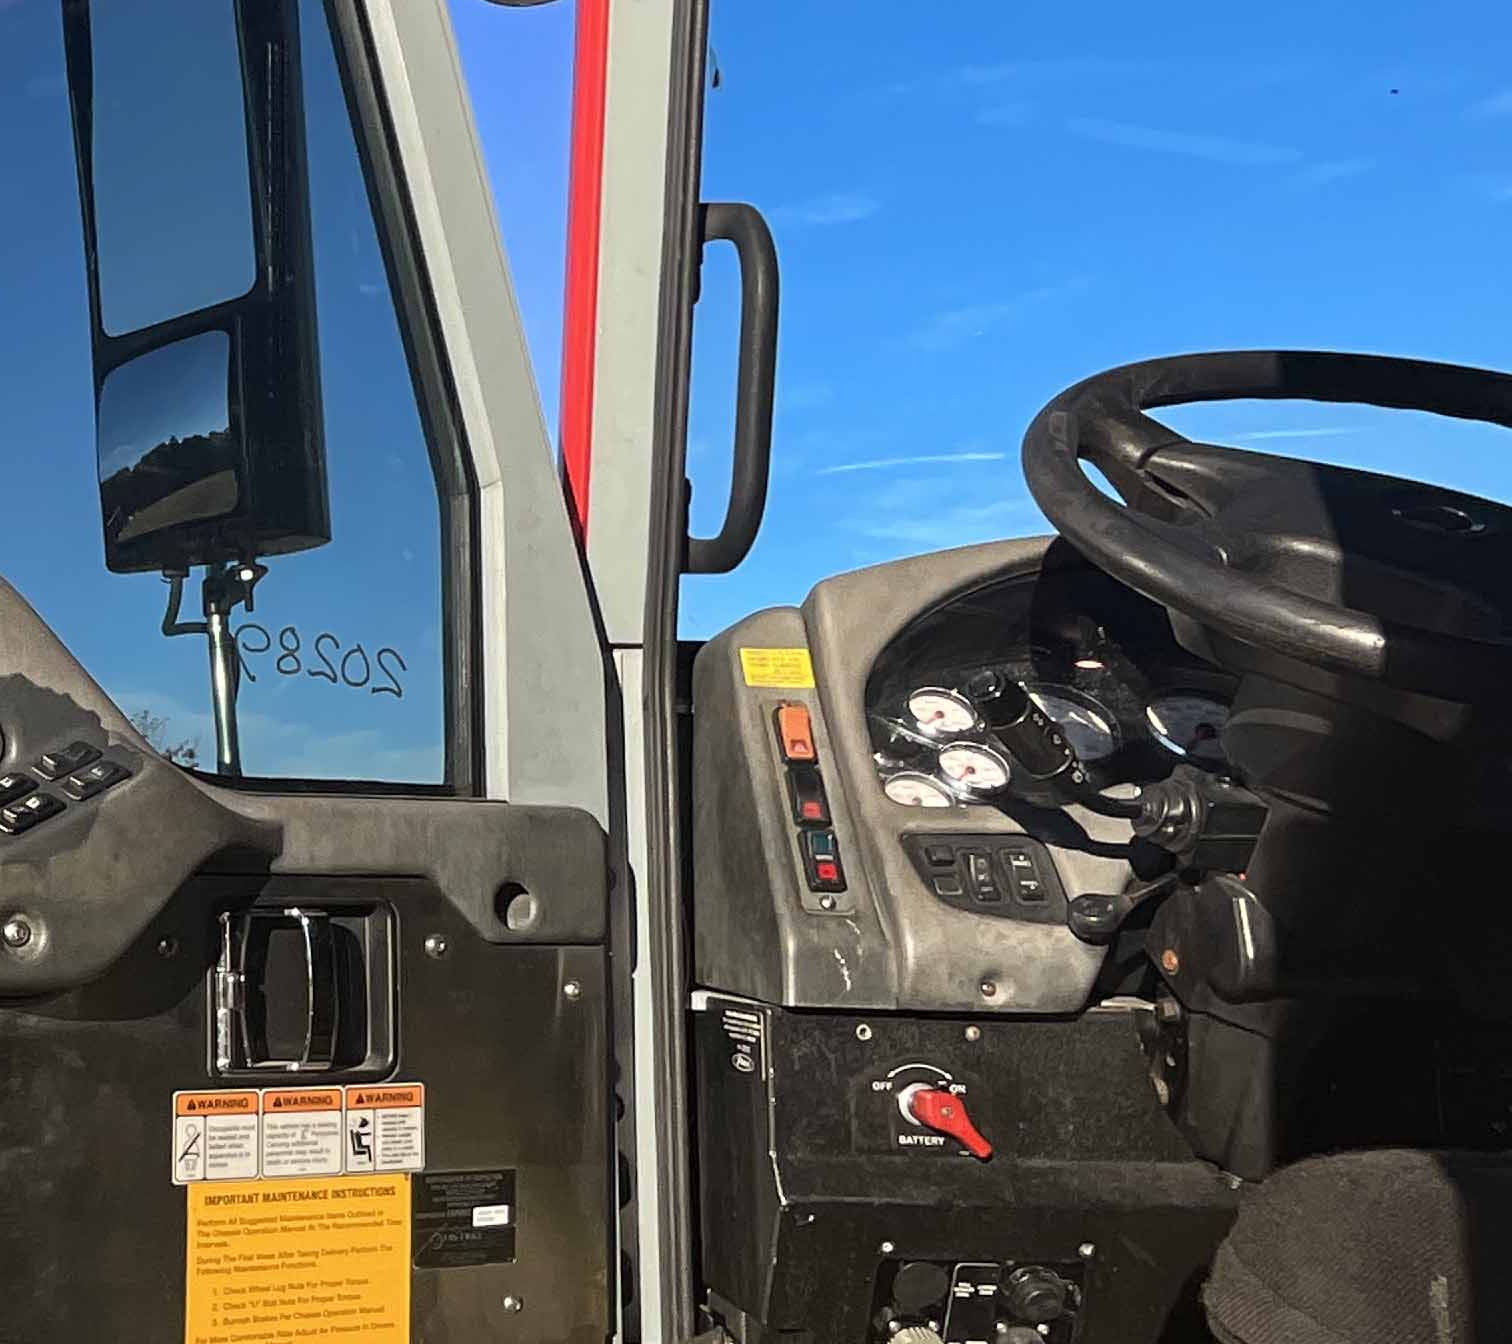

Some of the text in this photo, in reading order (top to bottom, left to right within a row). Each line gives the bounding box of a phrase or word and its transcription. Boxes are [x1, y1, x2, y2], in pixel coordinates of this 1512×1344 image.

[872, 1082, 892, 1090] OFF
[949, 1084, 966, 1094] ON
[282, 1096, 333, 1106] WARNING
[366, 1092, 414, 1103] WARNING
[197, 1098, 249, 1109] WARNING
[898, 1136, 945, 1145] BATTERY
[204, 1186, 396, 1206] IMPORTANT MAINTENANCE INSTRUCTIONS
